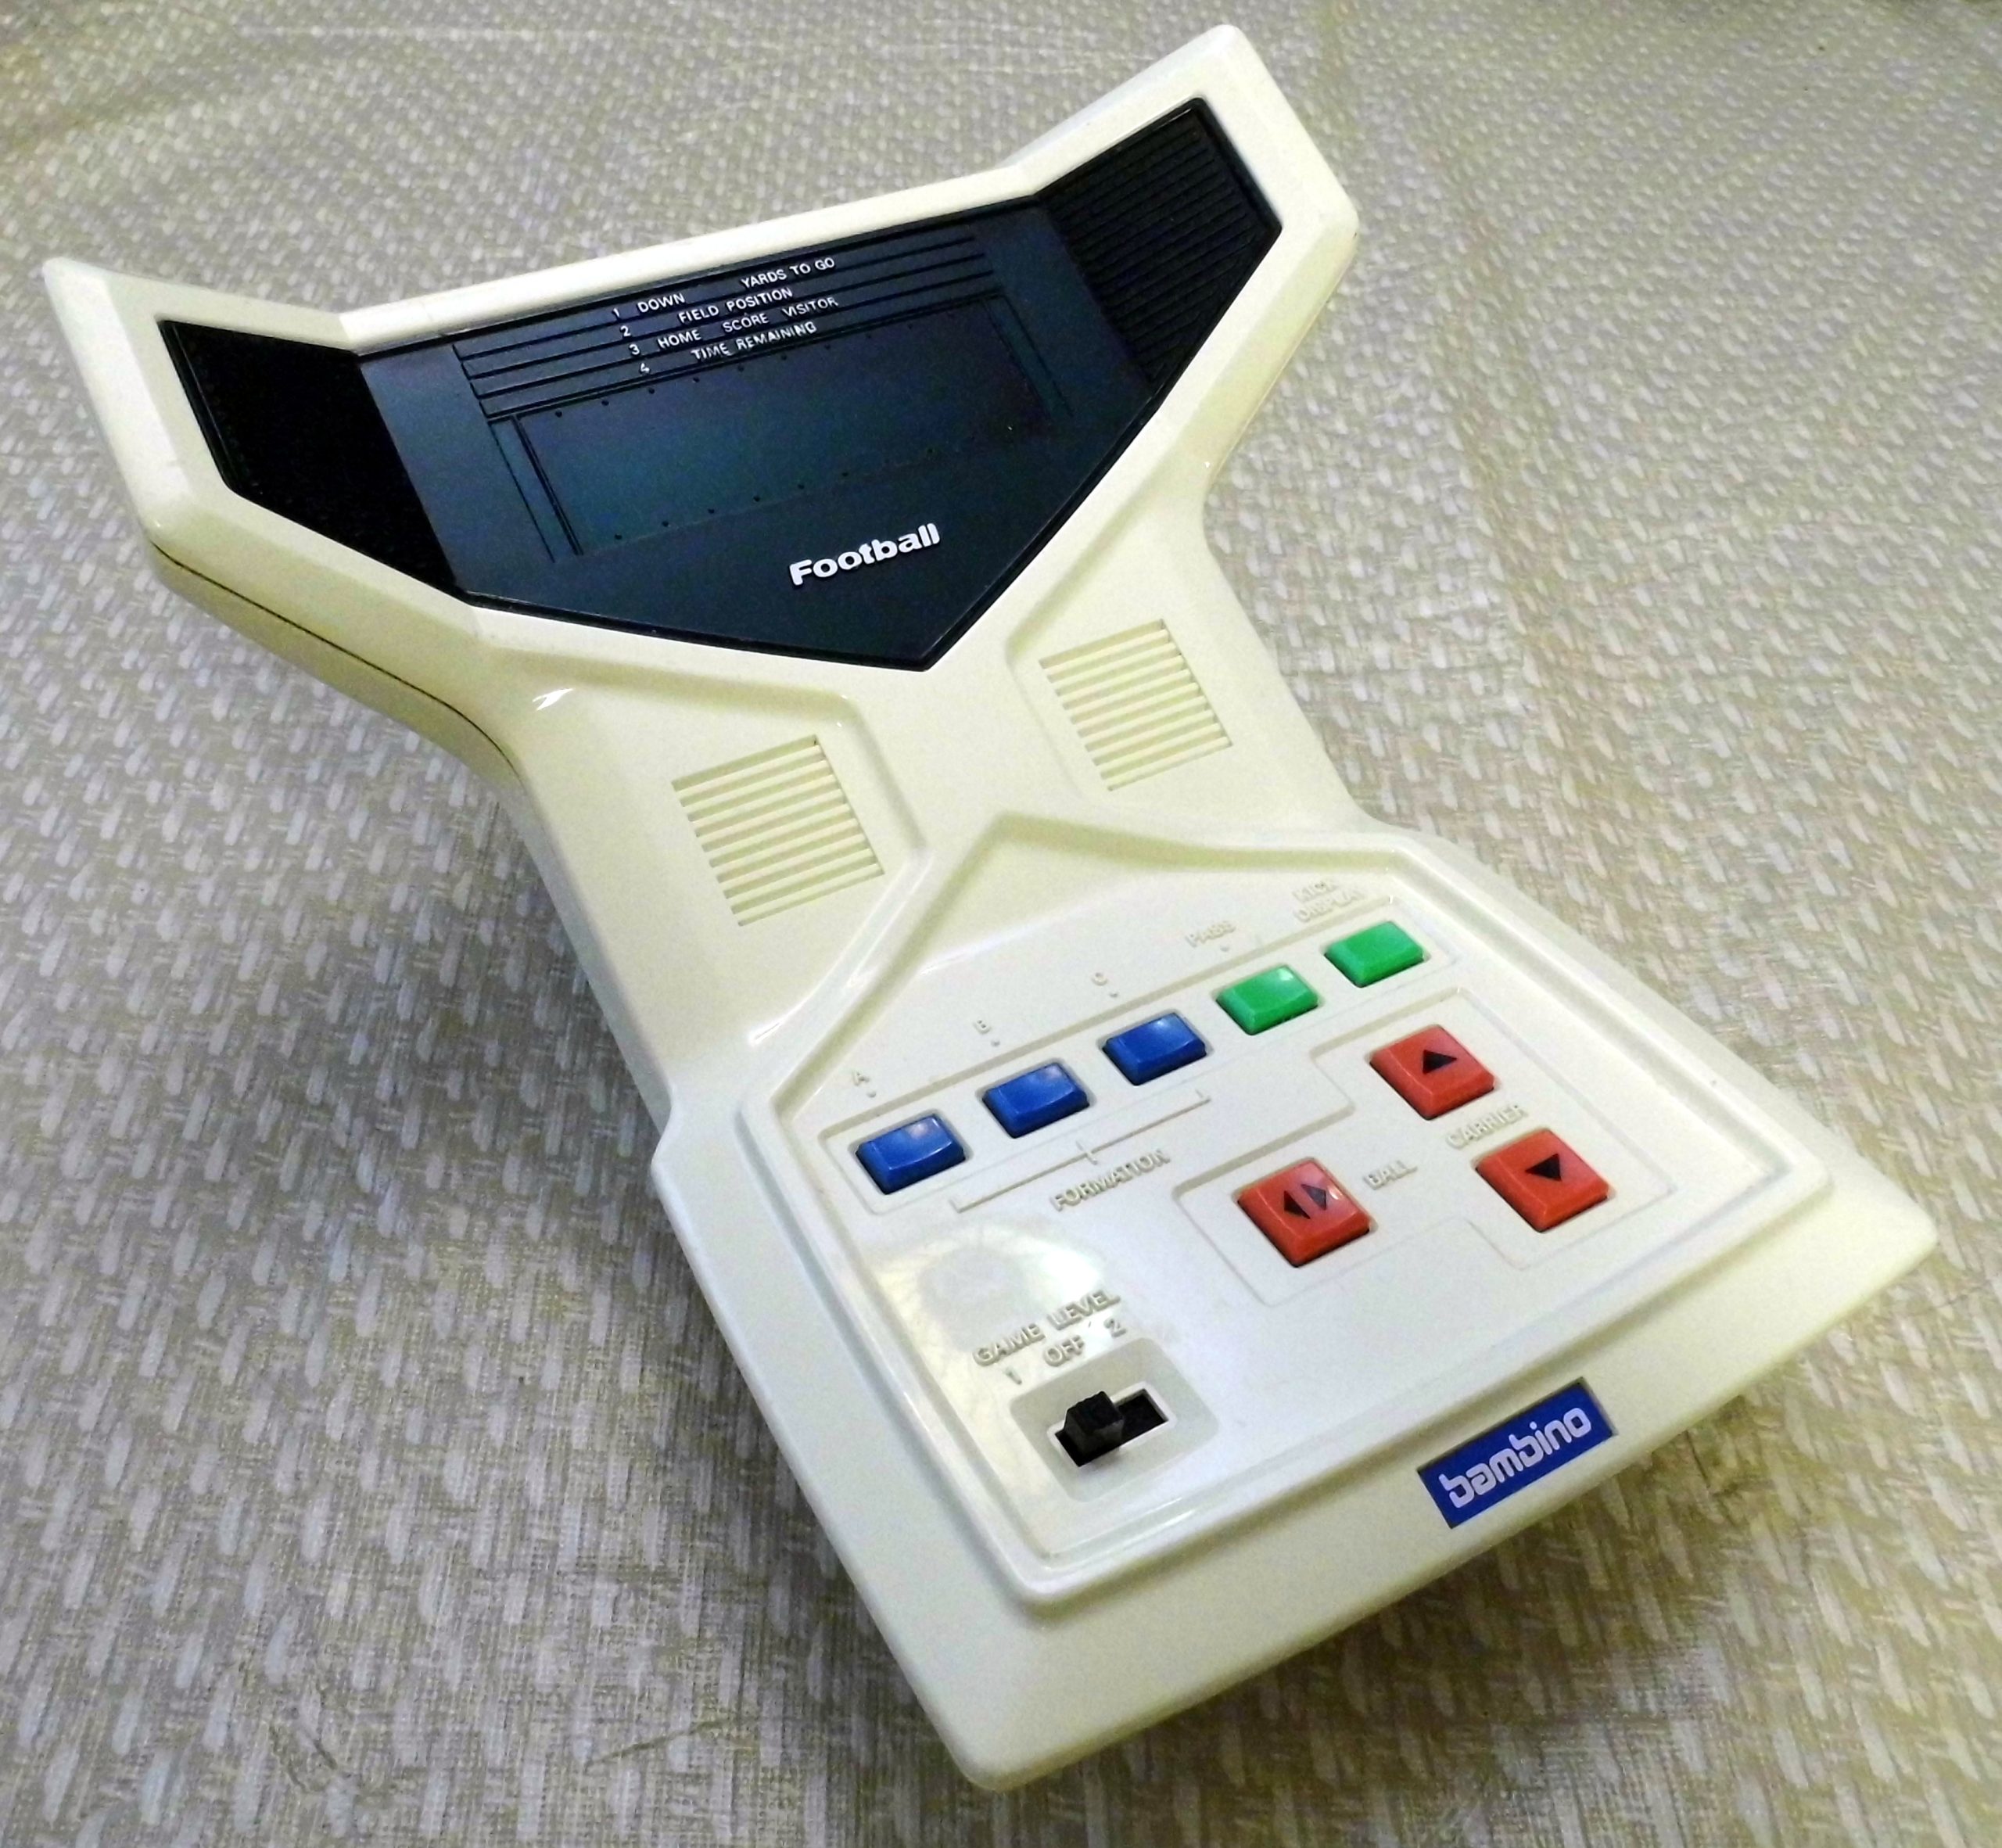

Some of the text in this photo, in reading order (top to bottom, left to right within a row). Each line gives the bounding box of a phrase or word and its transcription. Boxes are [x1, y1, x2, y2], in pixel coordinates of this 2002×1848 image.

[612, 257, 835, 318] 1 DOWN YARDS TO GO
[619, 287, 793, 337] 2 FIELD POSITION
[629, 296, 838, 356] 3 HOME SCORE VISITOR
[691, 345, 730, 361] TIME
[735, 321, 817, 350] REMAINING
[789, 522, 941, 586] Football
[1092, 972, 1107, 986] C
[973, 1019, 991, 1035] B
[852, 1071, 870, 1087] A
[1446, 1104, 1529, 1150] CARRIER
[1049, 1148, 1171, 1211] FORMATION
[1362, 1159, 1418, 1190] BALL
[973, 1290, 1121, 1367] GAME LEVEL
[1042, 1334, 1085, 1368] OFF
[1103, 1319, 1127, 1338] 2
[1438, 1407, 1592, 1509] bambino
